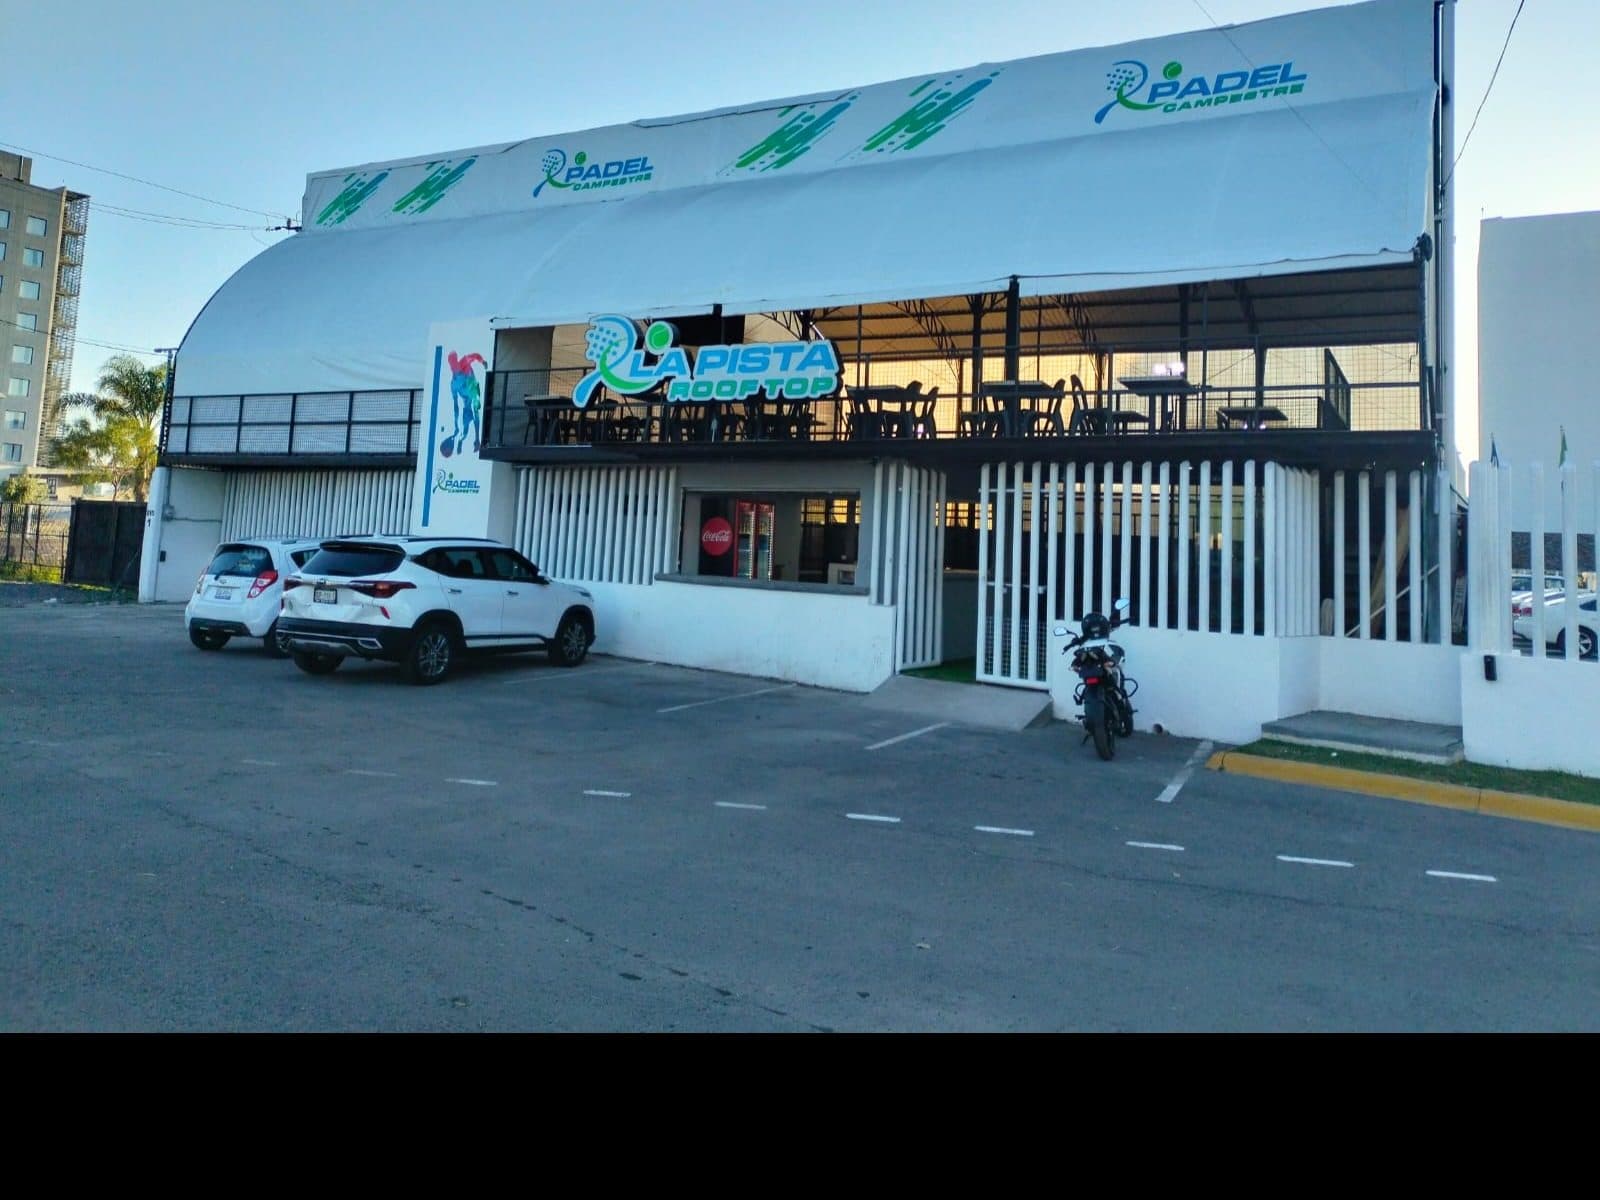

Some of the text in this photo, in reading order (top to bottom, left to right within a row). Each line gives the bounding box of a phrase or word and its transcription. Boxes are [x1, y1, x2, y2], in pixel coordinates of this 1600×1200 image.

[1148, 62, 1307, 103] PADEL
[1163, 84, 1304, 113] CAMPESTRE
[566, 157, 653, 182] PADEL
[574, 173, 651, 191] CAMPESTRE
[631, 346, 835, 377] LA PISTA
[446, 480, 480, 488] PADEL
